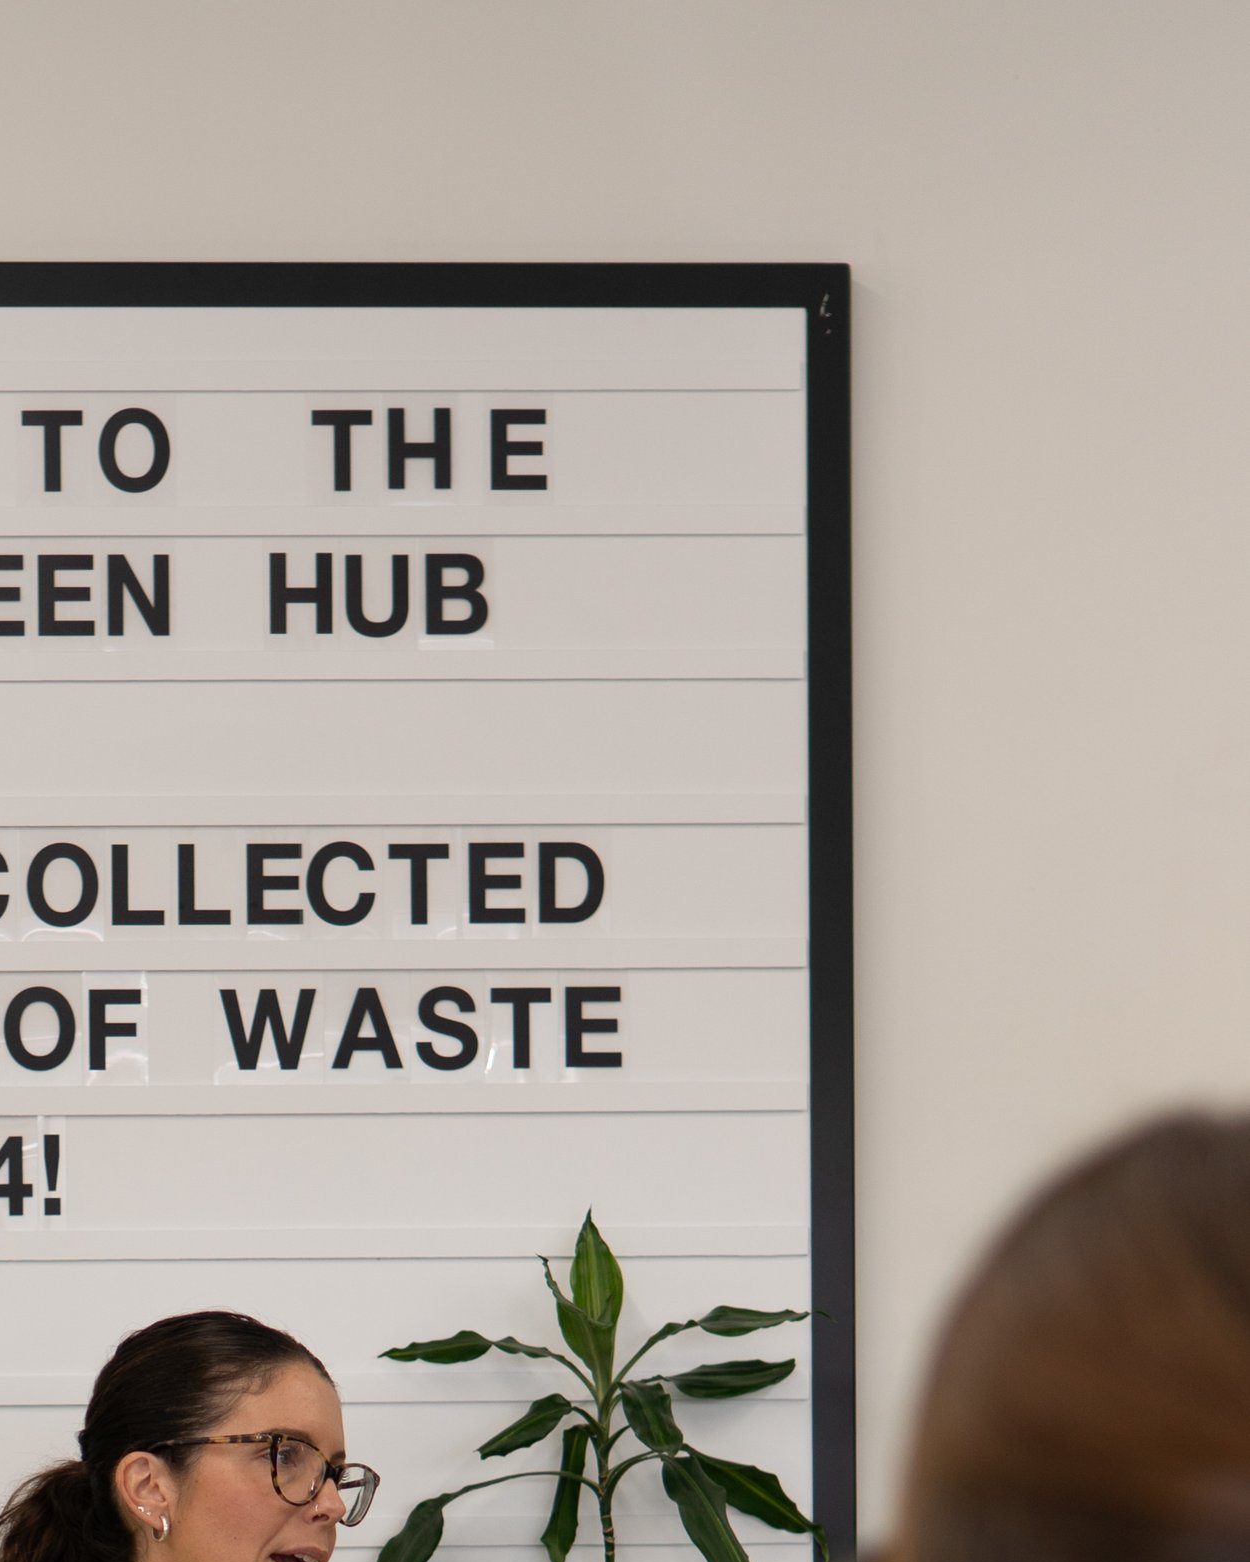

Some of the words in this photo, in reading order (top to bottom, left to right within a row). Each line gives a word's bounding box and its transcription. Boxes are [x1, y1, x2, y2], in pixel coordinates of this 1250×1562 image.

[21, 407, 171, 494] TO
[311, 407, 548, 493] THE
[269, 552, 489, 639] HUB
[3, 986, 142, 1072] OF
[219, 985, 623, 1071] WASTE
